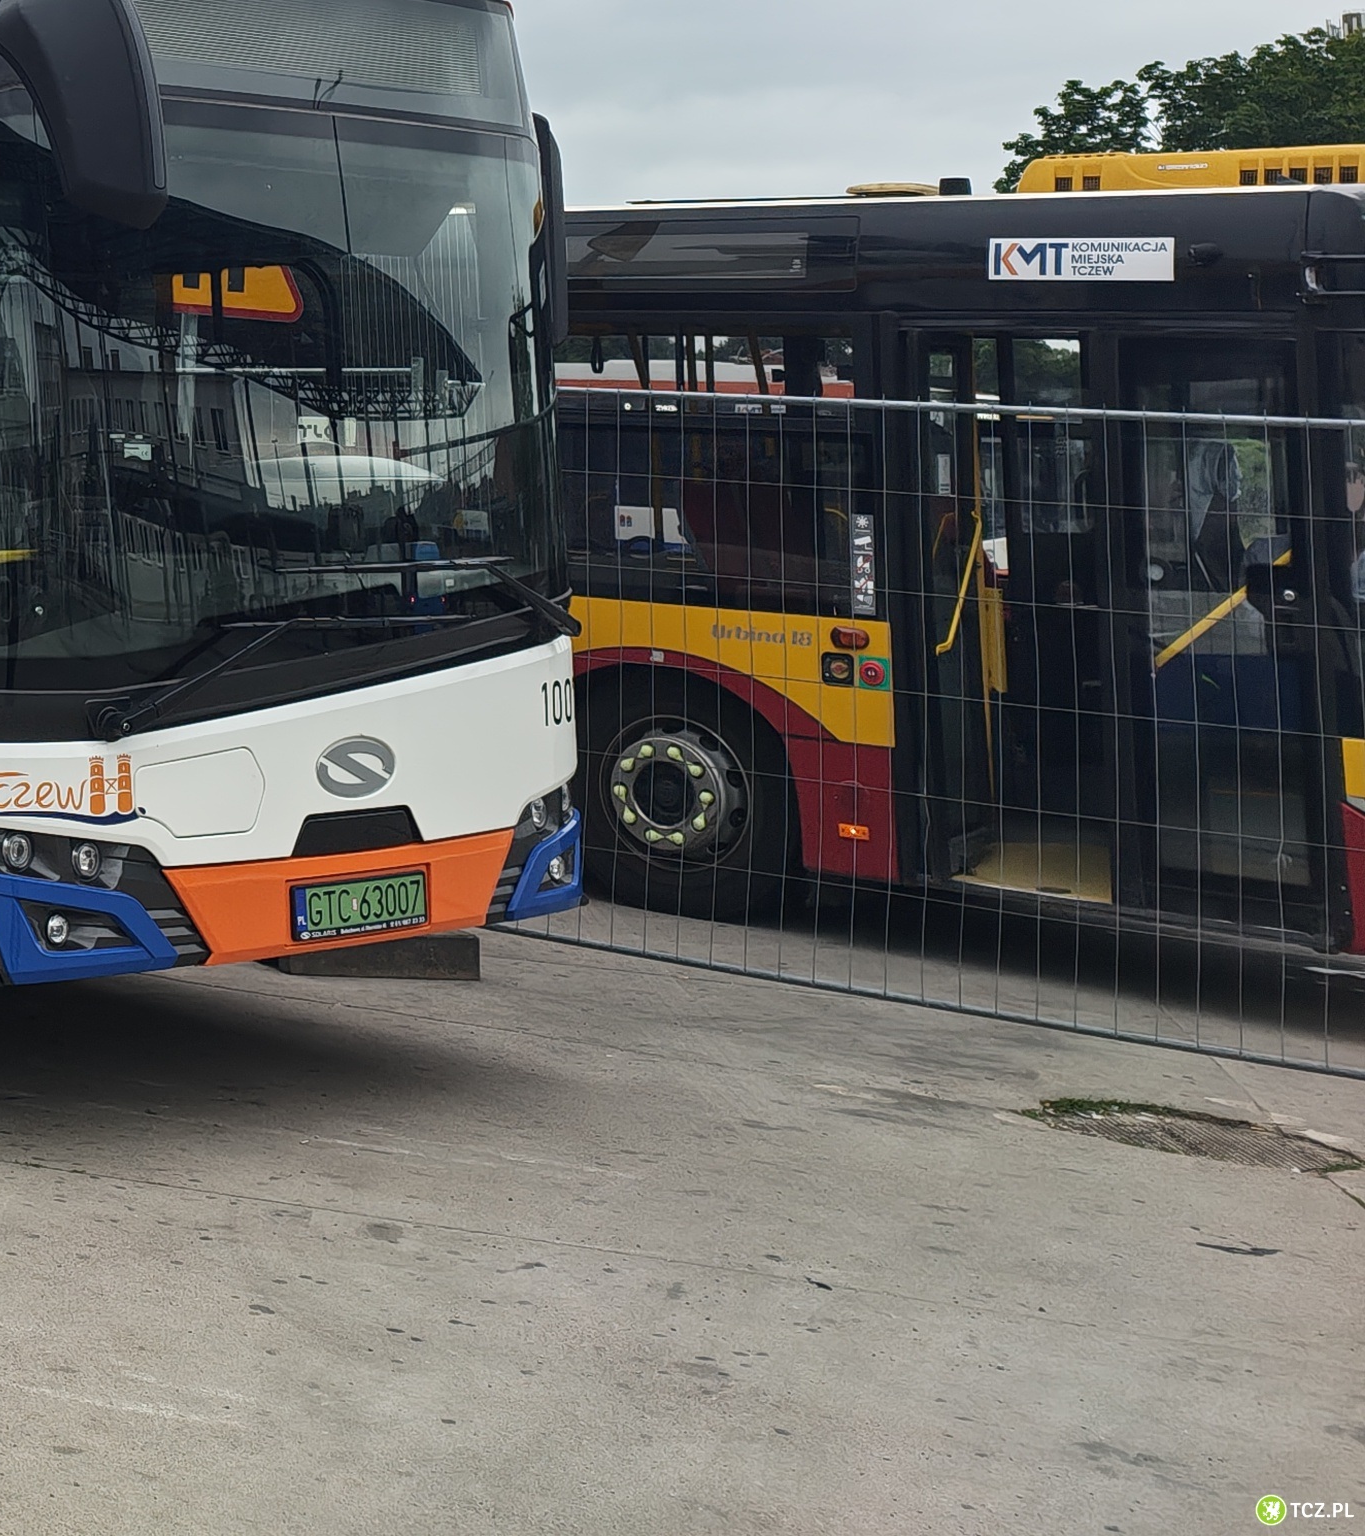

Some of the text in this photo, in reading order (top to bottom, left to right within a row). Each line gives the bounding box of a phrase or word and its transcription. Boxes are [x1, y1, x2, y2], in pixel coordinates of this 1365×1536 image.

[1071, 241, 1168, 253] KOMUNIKACJA
[994, 242, 1069, 276] KMT
[1071, 253, 1125, 265] MIEJSKA
[1071, 265, 1116, 276] TCZEW
[308, 879, 421, 927] GTC 63007
[297, 916, 306, 926] PL
